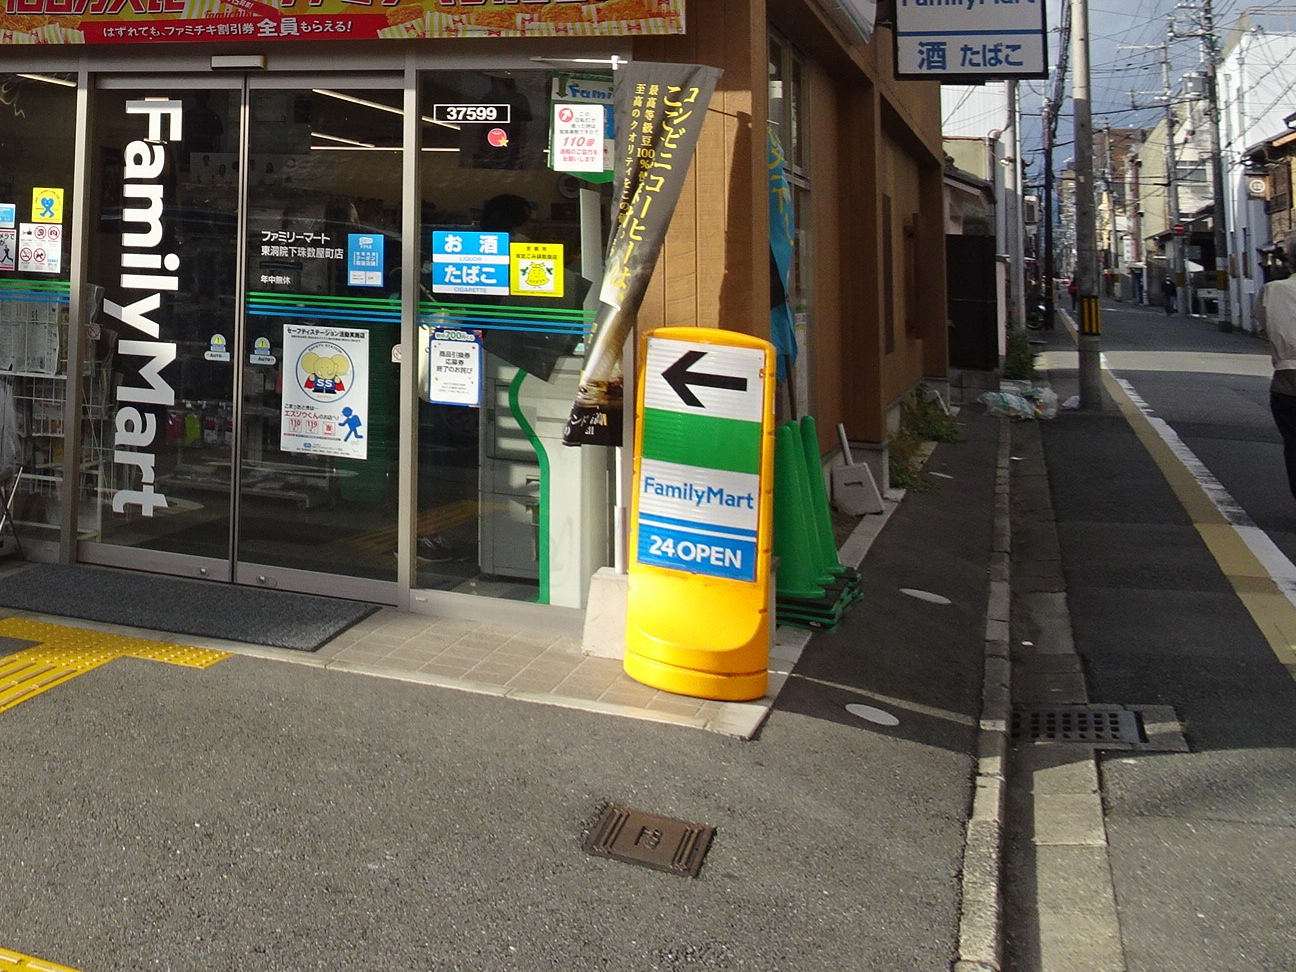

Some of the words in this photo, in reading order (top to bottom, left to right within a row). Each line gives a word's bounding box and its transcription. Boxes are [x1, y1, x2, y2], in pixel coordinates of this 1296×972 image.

[917, 41, 947, 70] 酒
[960, 42, 1024, 68] たばこ
[446, 106, 498, 121] 37599
[564, 136, 596, 147] 110番
[261, 231, 331, 244] ファミリーマート
[444, 234, 499, 254] お酒
[261, 245, 344, 260] 東洞院下珠数屋町店
[260, 275, 292, 285] 年中無休
[444, 264, 497, 284] たばこ
[103, 100, 182, 518] FamilyMart
[317, 379, 333, 388] SS
[644, 476, 754, 510] FamilyMart
